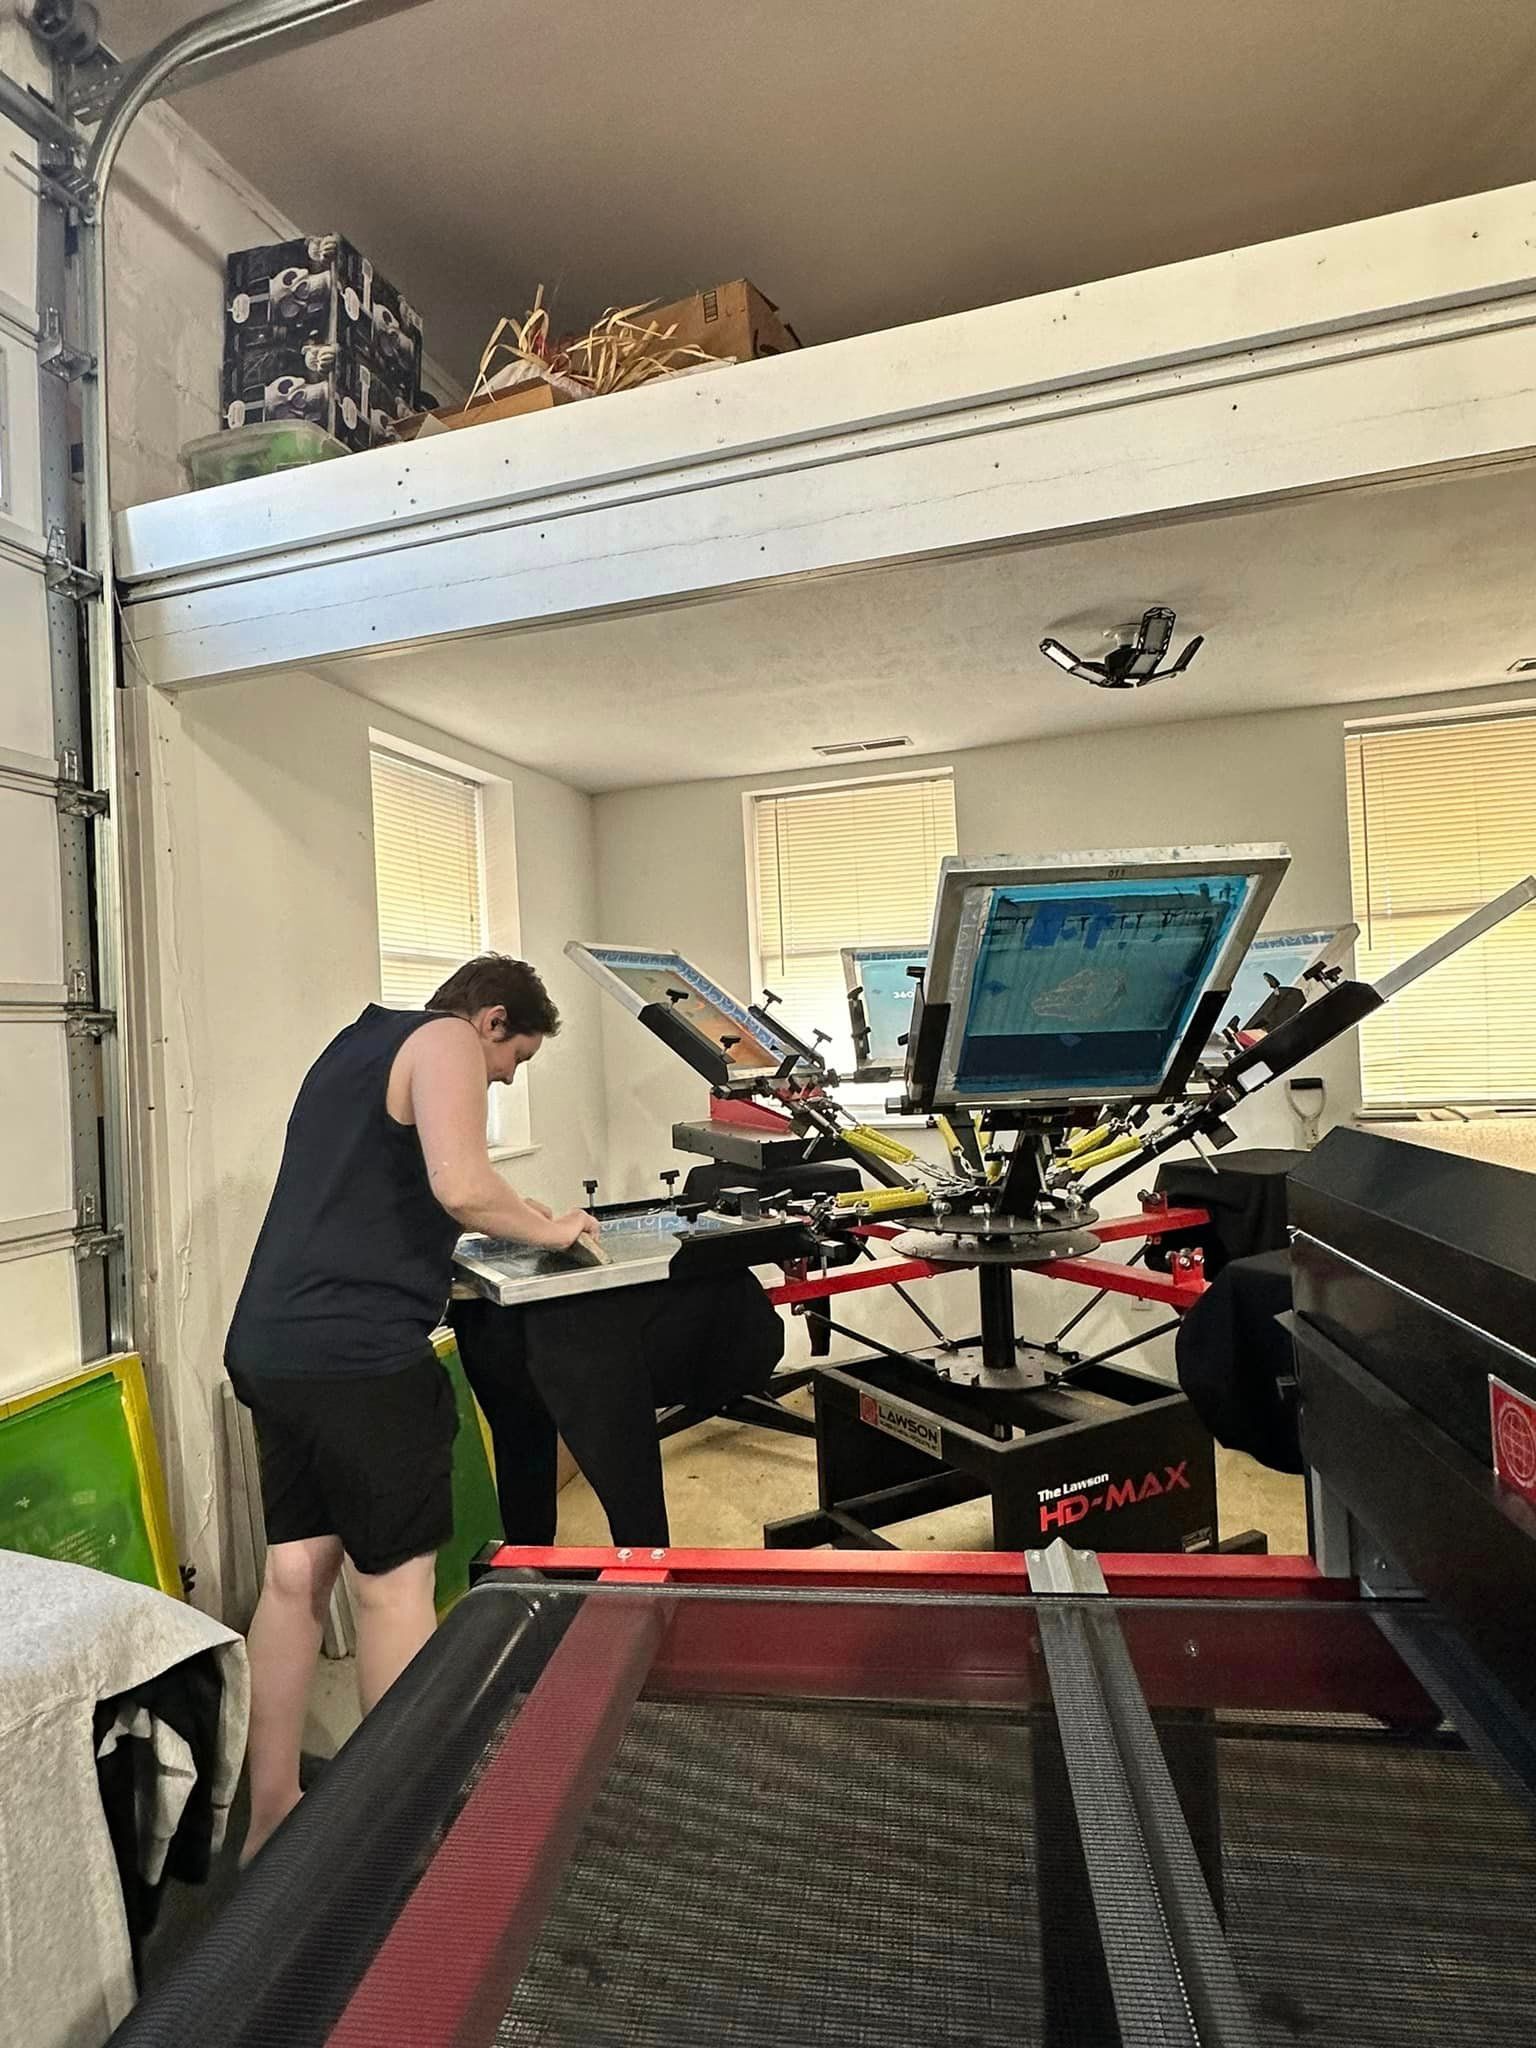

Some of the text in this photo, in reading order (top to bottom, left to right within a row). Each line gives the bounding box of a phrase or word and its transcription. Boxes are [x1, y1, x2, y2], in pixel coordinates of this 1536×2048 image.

[878, 1405, 938, 1444] LAWSON
[1037, 1473, 1110, 1503] The Lawson
[1039, 1460, 1191, 1532] HD-MAX
